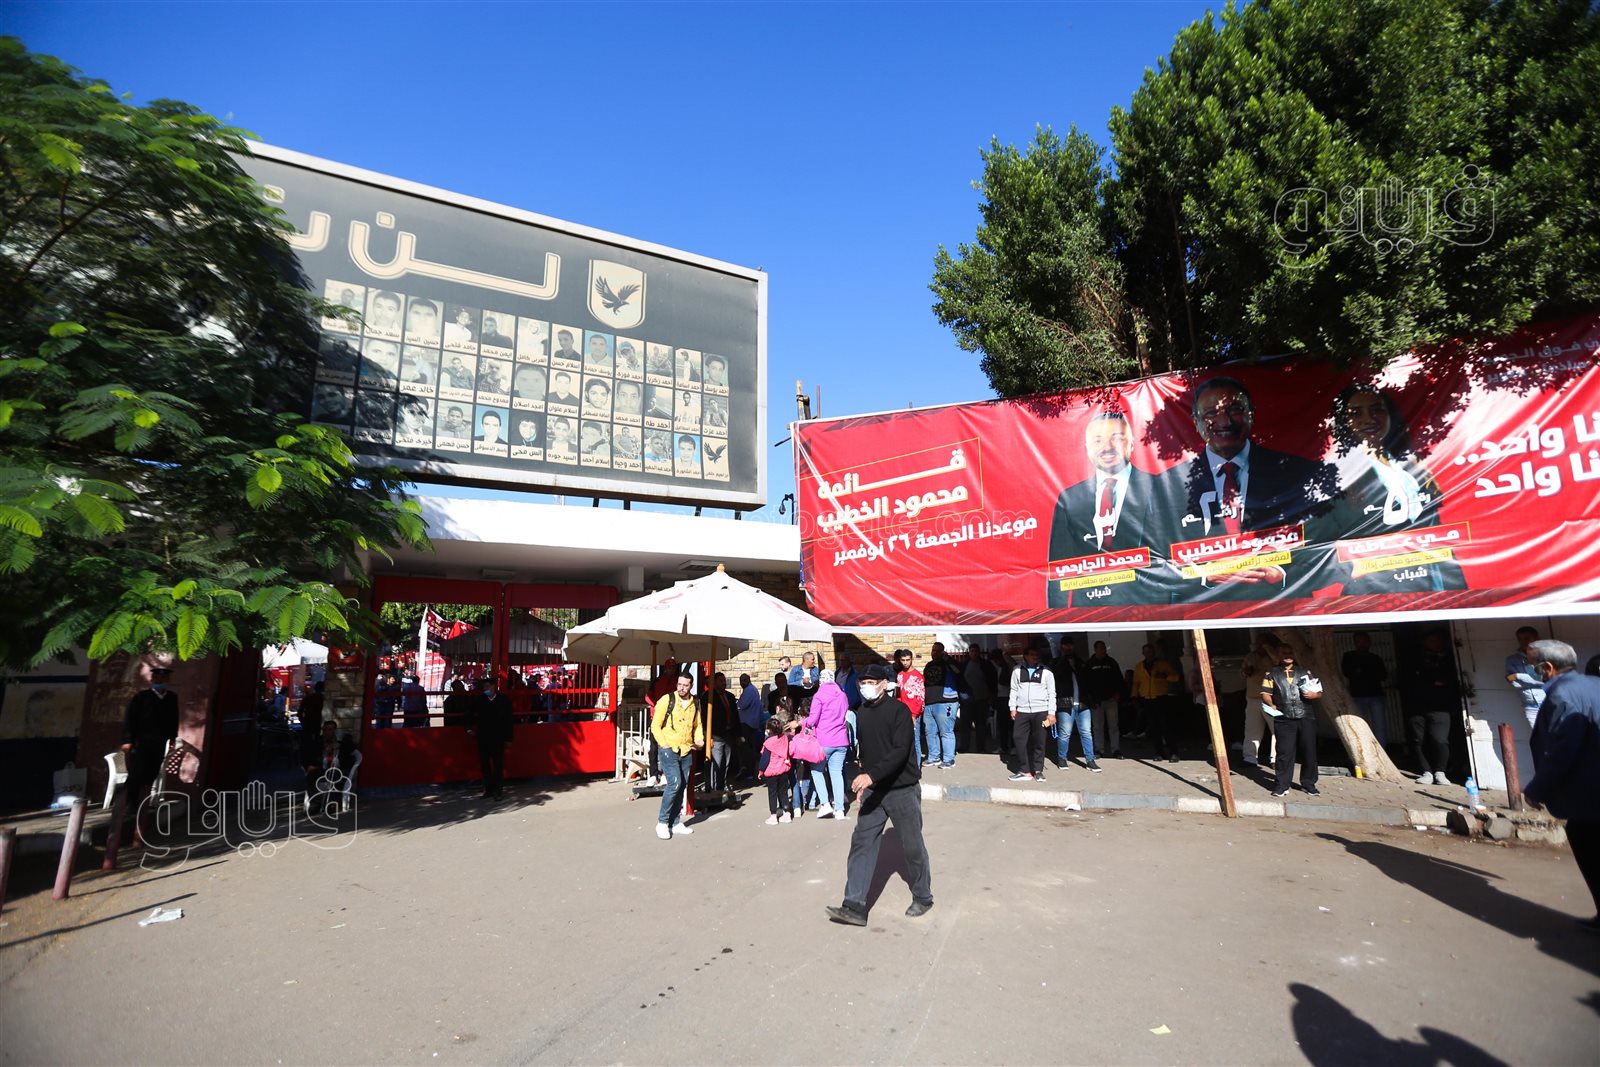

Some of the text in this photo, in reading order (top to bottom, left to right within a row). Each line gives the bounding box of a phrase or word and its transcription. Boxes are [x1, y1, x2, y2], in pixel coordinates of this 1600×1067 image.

[349, 211, 561, 300] لن
[817, 448, 967, 499] قائمة
[1474, 461, 1562, 498] واحد
[816, 485, 969, 533] محمود الخطيب
[833, 517, 1038, 567] موعدنا الجمعة ٢٦ نوفمبر
[1177, 532, 1299, 563] محمود الخطيب
[1055, 553, 1144, 577] محمد الجارحي
[1393, 566, 1428, 582] شباب
[1086, 586, 1112, 600] شباب
